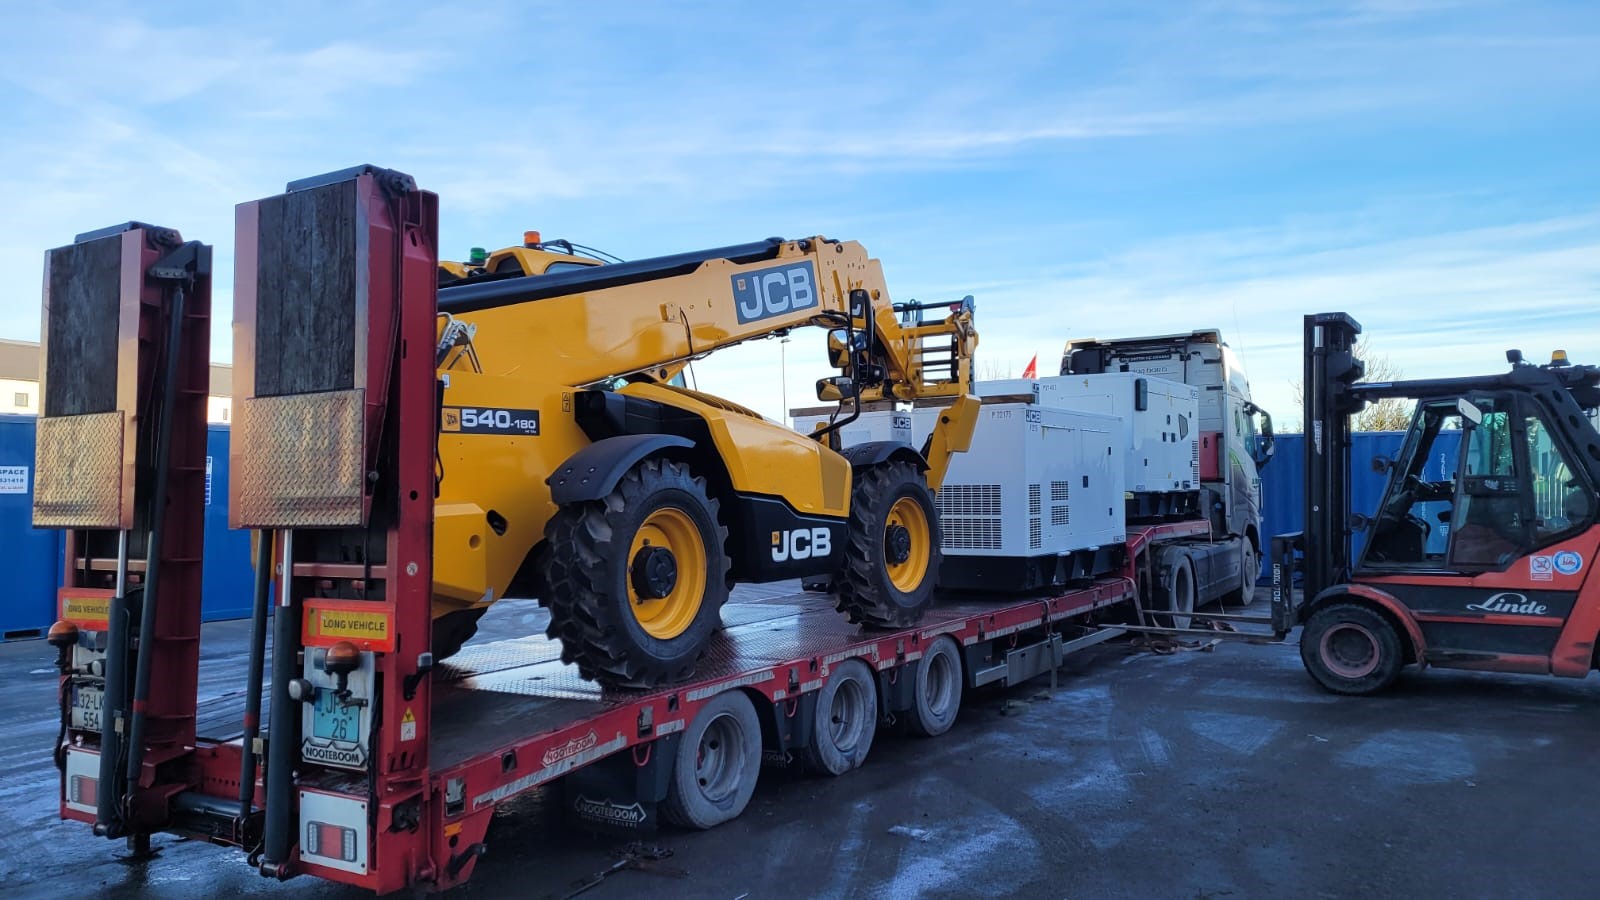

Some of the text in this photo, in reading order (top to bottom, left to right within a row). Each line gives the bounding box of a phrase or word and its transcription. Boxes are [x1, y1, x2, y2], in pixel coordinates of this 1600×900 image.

[740, 267, 813, 319] JCB
[894, 416, 911, 428] JCB
[1026, 410, 1041, 423] JCB
[771, 527, 831, 562] JCB
[1466, 592, 1547, 615] Linde
[323, 619, 385, 631] LONG VEHICLE
[331, 717, 348, 740] 26
[305, 746, 360, 763] NOOTEBOOM
[545, 735, 595, 762] NOOTEBOOM
[583, 803, 638, 820] NOOTEBOOM
